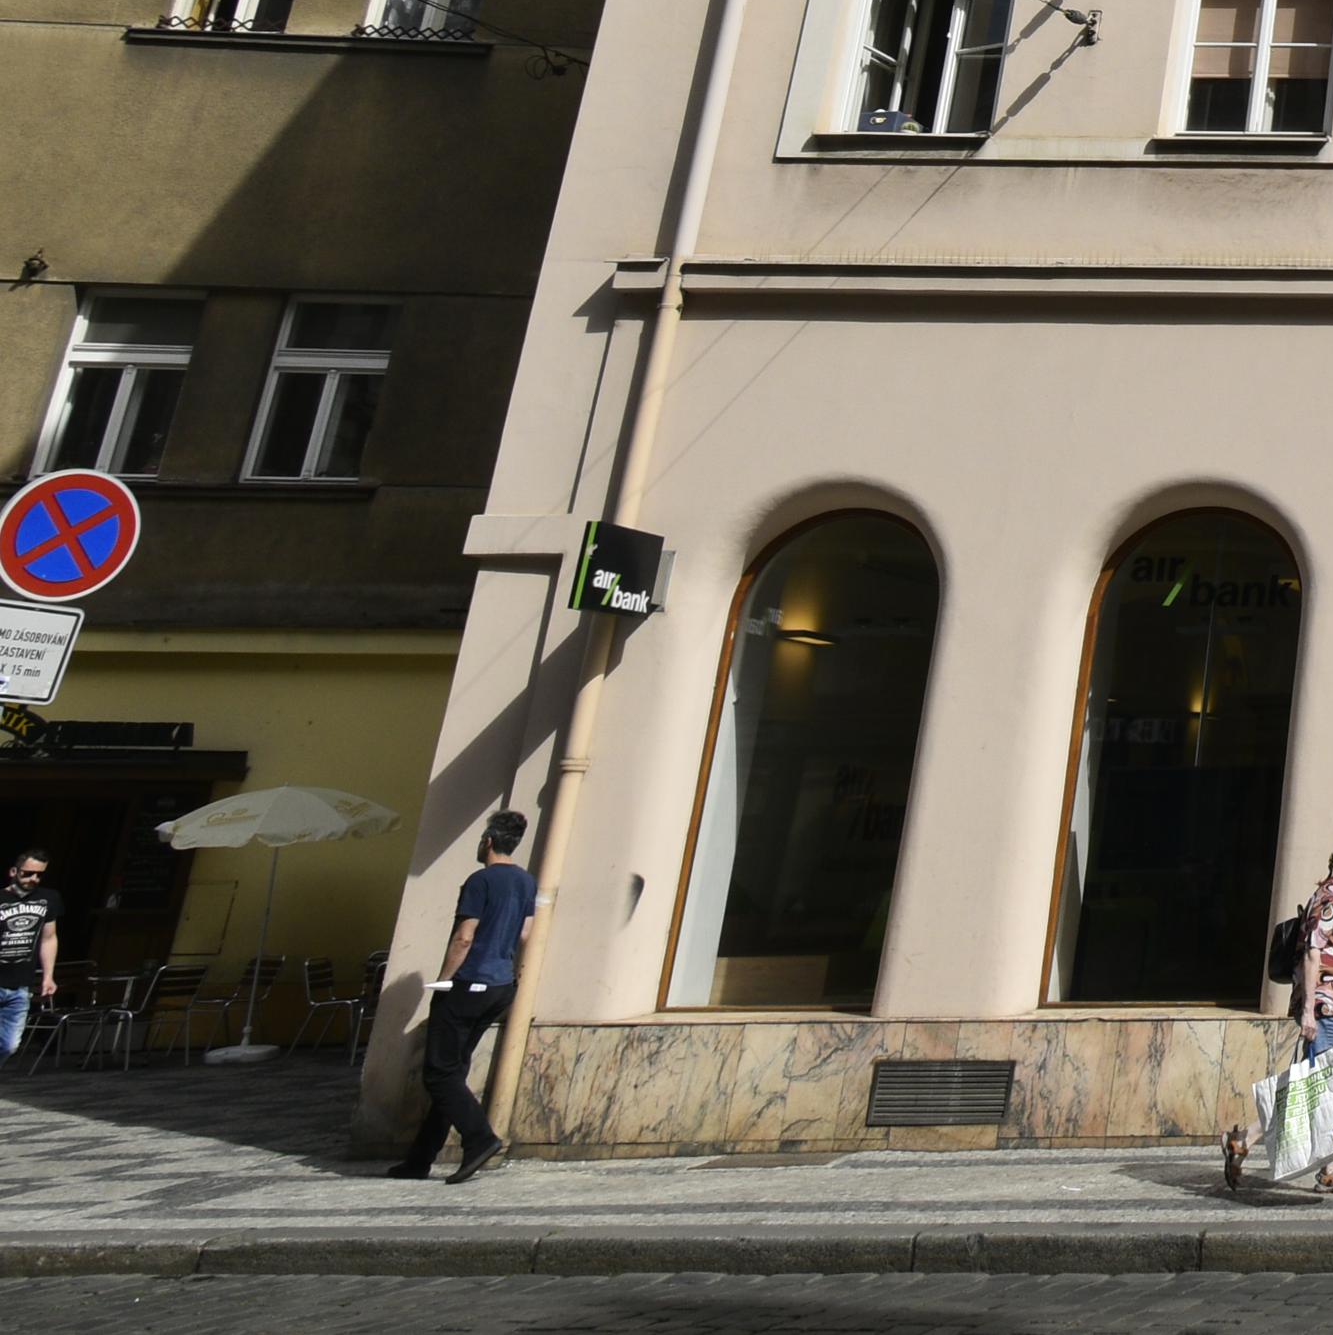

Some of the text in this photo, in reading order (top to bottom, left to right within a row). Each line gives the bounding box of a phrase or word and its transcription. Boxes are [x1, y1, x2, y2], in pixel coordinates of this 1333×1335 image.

[610, 585, 650, 614] bank
[13, 627, 69, 647] ZÁSOBOVÁNÍ
[11, 664, 22, 677] 15
[23, 665, 41, 678] min
